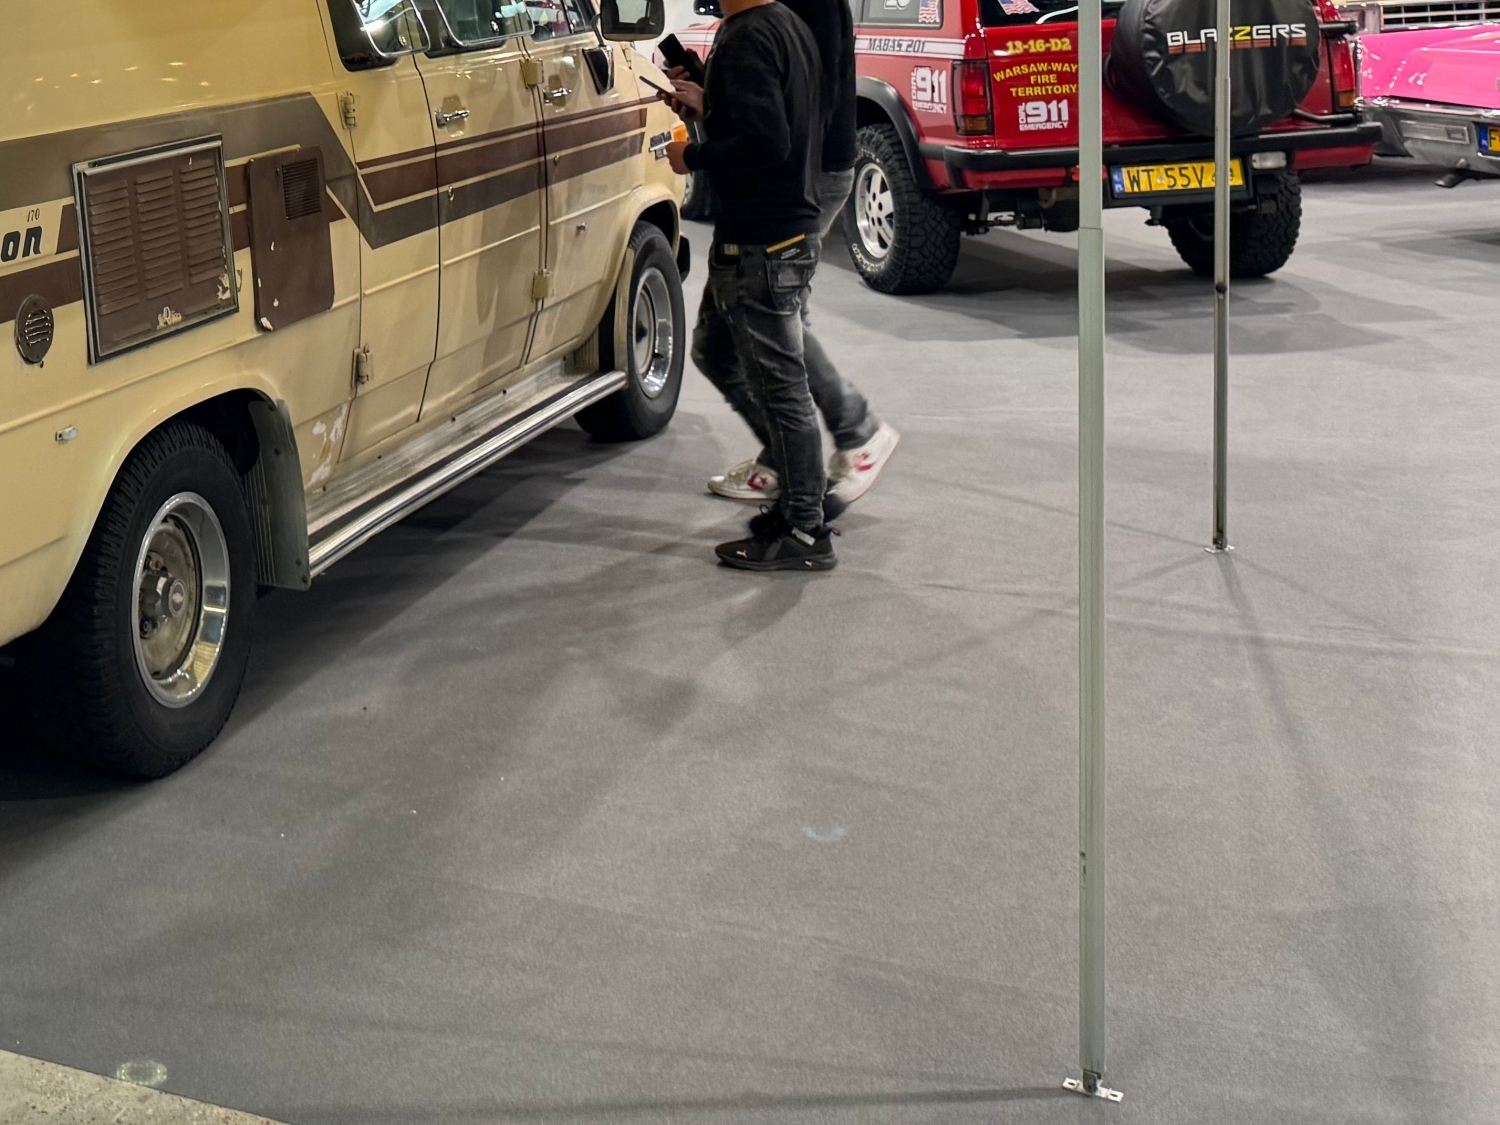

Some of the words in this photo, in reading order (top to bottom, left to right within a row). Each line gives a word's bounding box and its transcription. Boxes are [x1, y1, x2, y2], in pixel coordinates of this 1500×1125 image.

[1166, 23, 1307, 46] BLAZERS
[867, 38, 902, 52] MABAS
[905, 39, 926, 53] 201
[1006, 37, 1072, 54] 13-16-D2
[916, 66, 947, 104] 911
[1030, 74, 1058, 84] FIRE
[1010, 84, 1077, 97] TERRITORY
[1025, 99, 1069, 123] 911
[1019, 121, 1068, 131] EMERGENCY
[1126, 168, 1155, 192] WT
[1164, 166, 1204, 188] 55V
